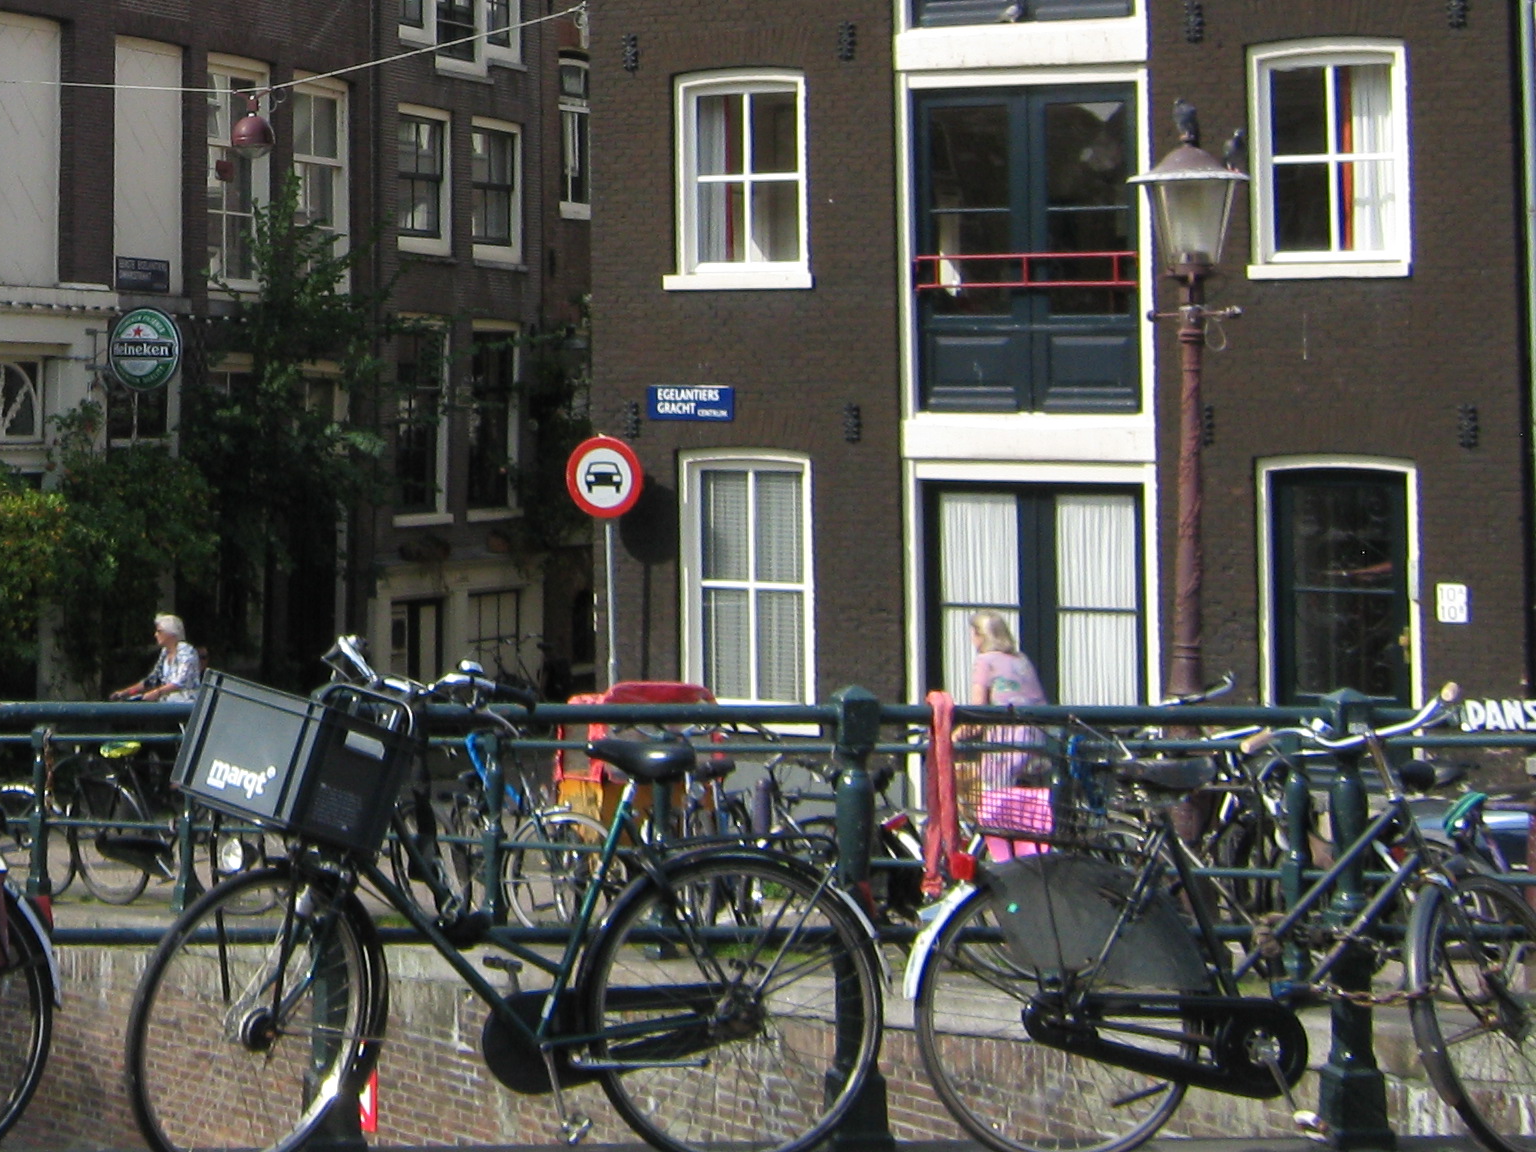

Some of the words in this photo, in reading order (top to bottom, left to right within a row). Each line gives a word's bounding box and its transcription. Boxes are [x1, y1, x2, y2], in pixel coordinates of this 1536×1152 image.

[657, 388, 720, 401] EGELANTIERS
[656, 402, 696, 415] GRACHT
[207, 759, 267, 799] marqt
